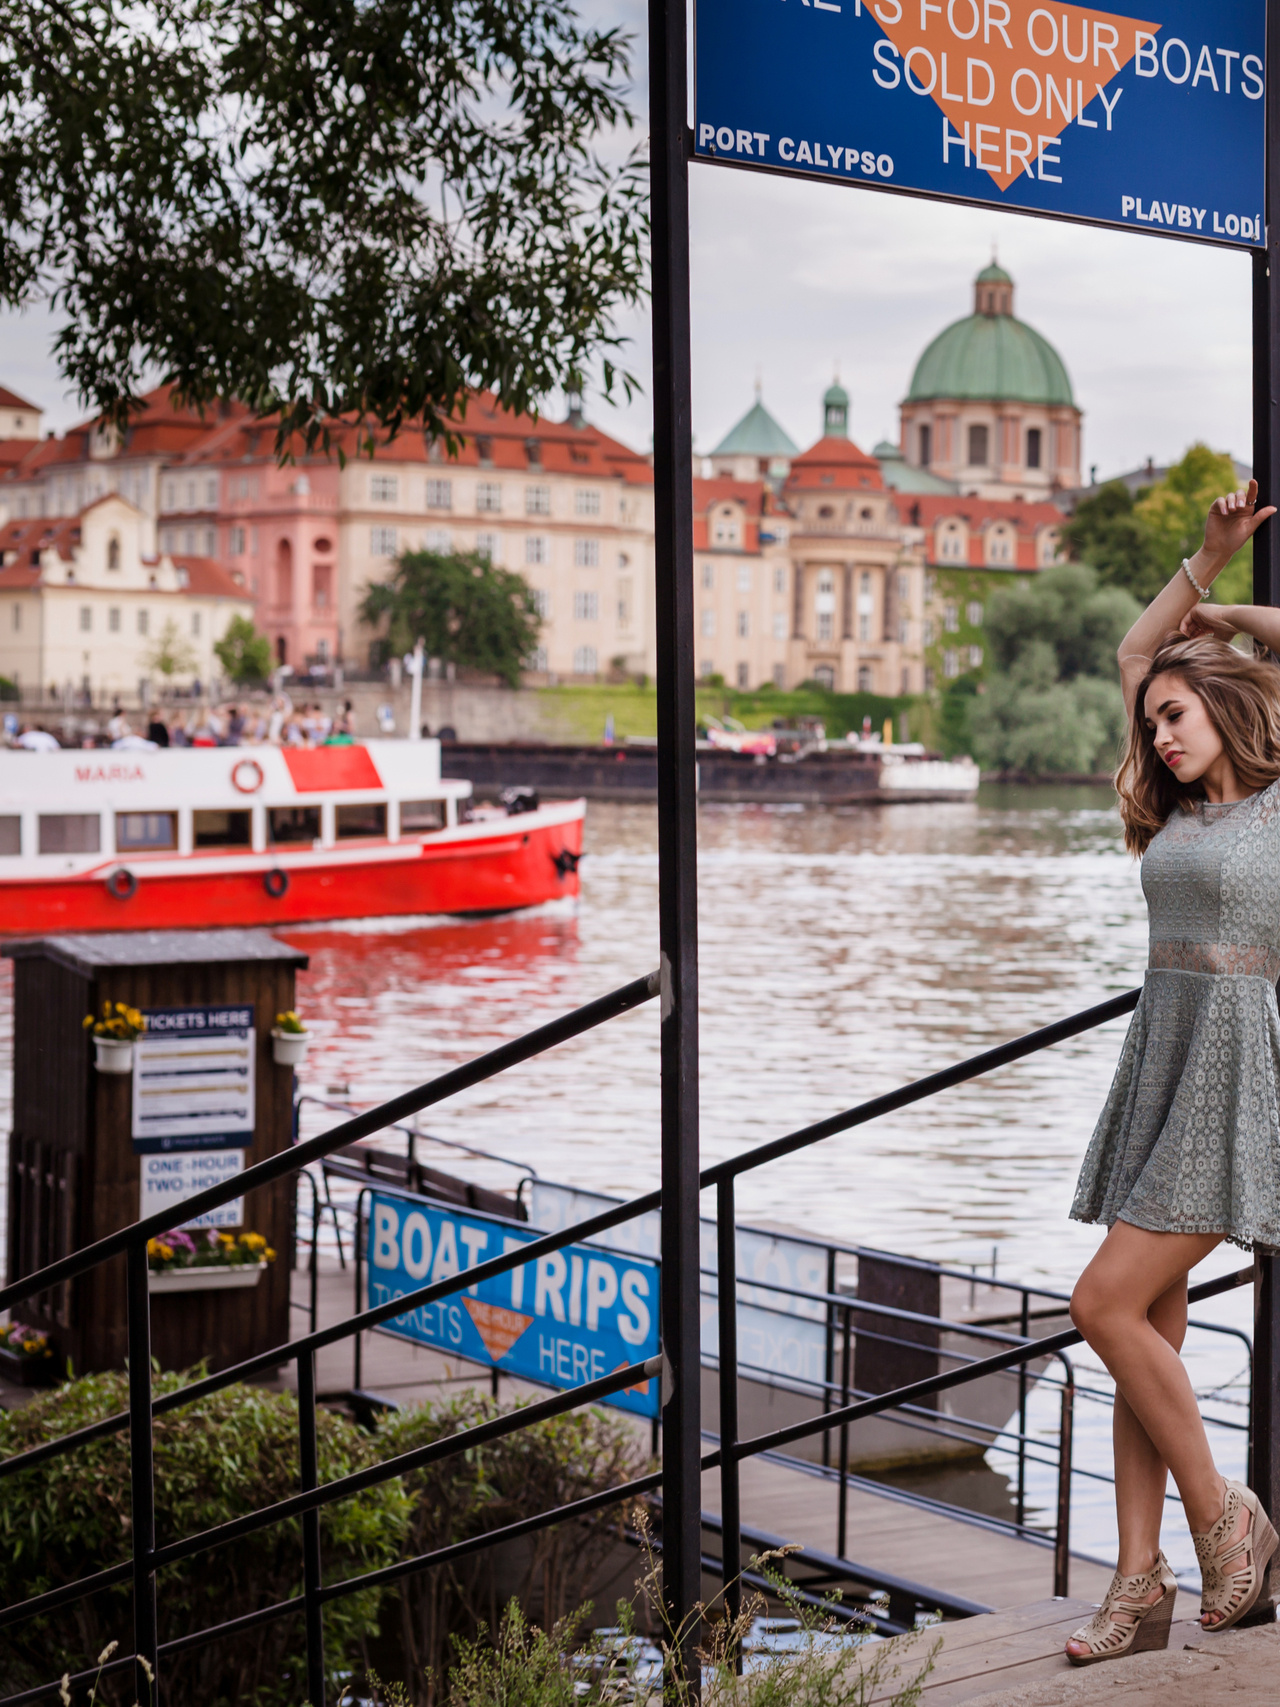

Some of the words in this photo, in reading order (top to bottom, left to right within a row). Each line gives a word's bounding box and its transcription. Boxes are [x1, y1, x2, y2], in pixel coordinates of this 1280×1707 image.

[919, 0, 1013, 49] FOR
[1026, 8, 1121, 72] OUR
[1134, 31, 1265, 101] BOATS
[872, 39, 996, 107] SOLD
[1010, 67, 1124, 132] ONLY
[698, 123, 770, 158] PORT
[777, 137, 894, 178] CALYPSO
[942, 116, 1063, 184] HERE
[1121, 195, 1207, 231] PLAVBY
[1212, 212, 1261, 242] LODÍ
[74, 764, 147, 783] MARIA
[143, 1011, 207, 1030] TICKETS
[208, 1010, 250, 1028] HERE
[374, 1202, 488, 1297] BOAT
[504, 1236, 650, 1346] TRIPS
[539, 1333, 606, 1384] HERE
